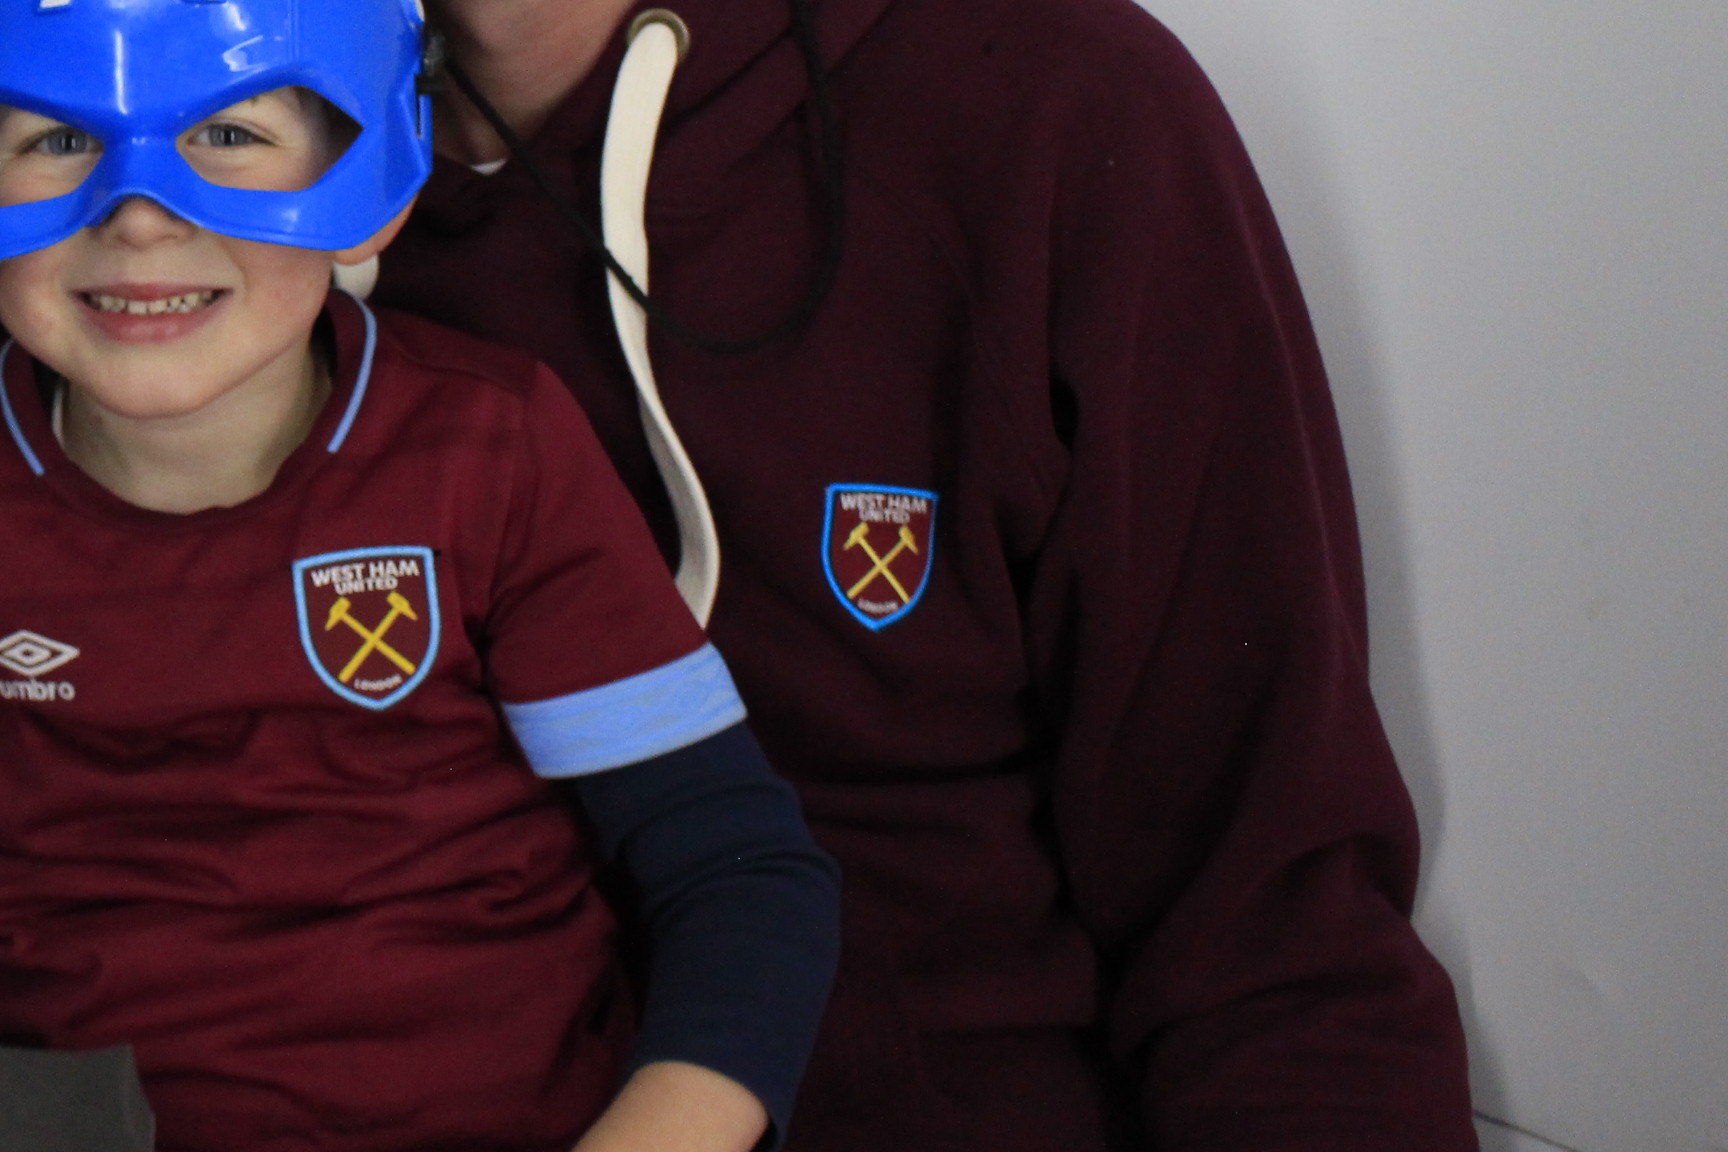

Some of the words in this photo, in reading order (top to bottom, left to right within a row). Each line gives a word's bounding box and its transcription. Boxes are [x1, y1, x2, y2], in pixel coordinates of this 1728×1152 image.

[840, 492, 886, 511] WEST
[887, 495, 927, 514] HAM
[859, 508, 910, 523] UNITED
[311, 563, 365, 588] WEST
[368, 559, 421, 577] HAM
[334, 575, 399, 596] UNITED
